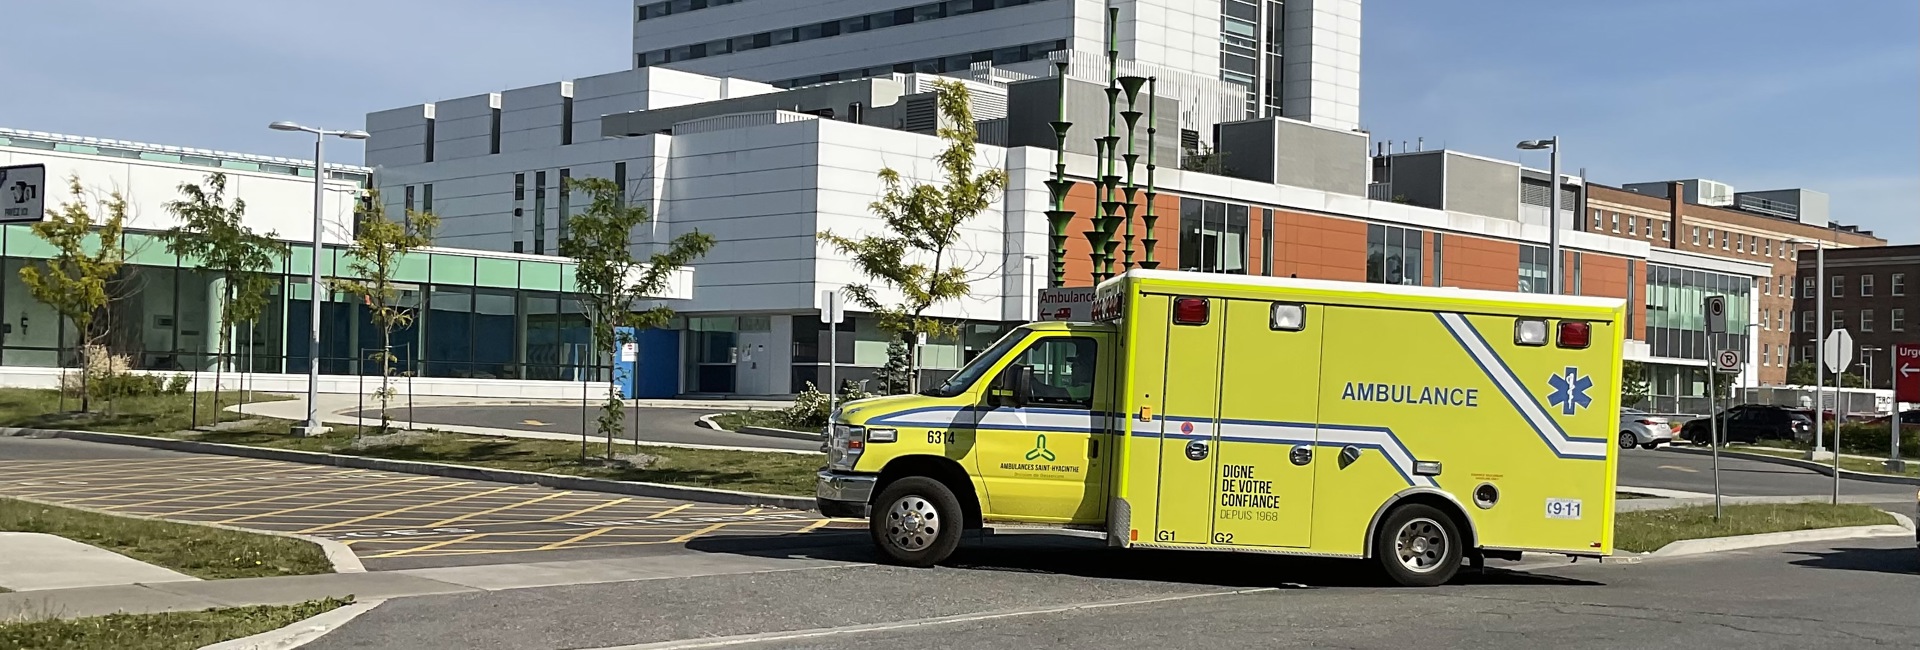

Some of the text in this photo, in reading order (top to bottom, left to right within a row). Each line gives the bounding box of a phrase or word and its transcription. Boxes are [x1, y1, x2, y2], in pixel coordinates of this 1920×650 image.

[1040, 290, 1097, 304] Ambulance
[1341, 381, 1478, 407] AMBULANCE
[927, 430, 955, 445] 6314
[1000, 462, 1034, 470] AMBULANCES
[1223, 464, 1254, 479] DIGNE
[1222, 479, 1272, 494] DE VOTRE
[1221, 493, 1280, 509] CONFIANCE
[1220, 509, 1278, 522] DEPUIS 1968
[1158, 530, 1175, 541] G1
[1214, 533, 1233, 543] G2
